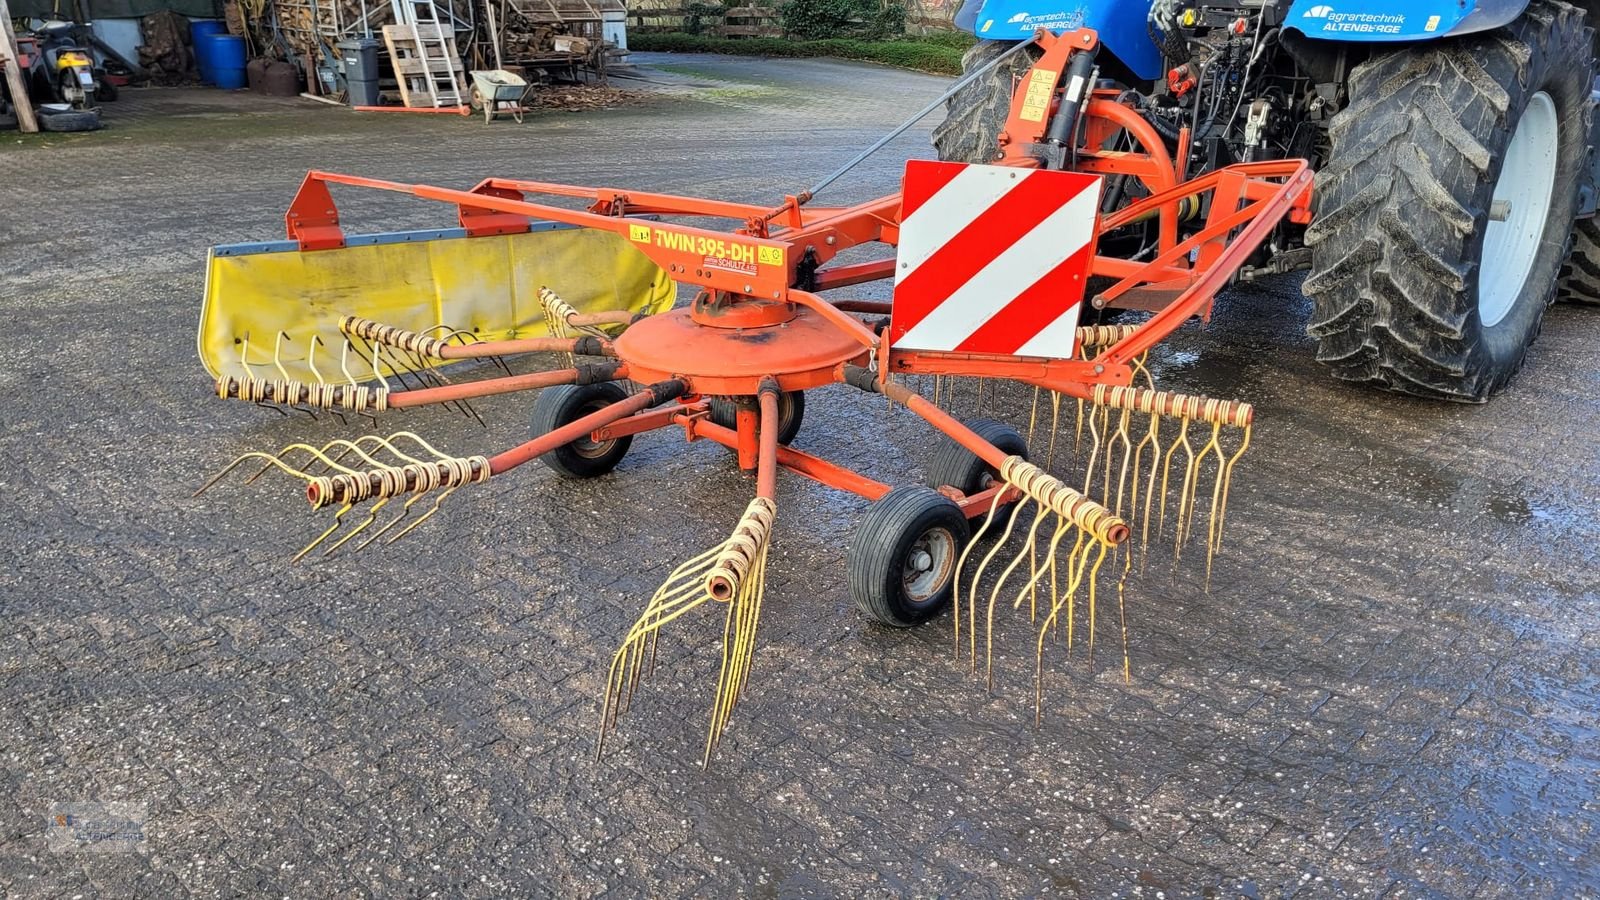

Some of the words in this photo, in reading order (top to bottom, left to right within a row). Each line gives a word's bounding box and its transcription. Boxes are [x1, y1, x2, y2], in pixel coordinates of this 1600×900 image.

[1328, 12, 1405, 23] agrartechnik
[1323, 22, 1402, 34] ALTENBERGE
[655, 229, 694, 253] TWIN
[698, 237, 754, 264] 395-DH
[718, 258, 746, 270] SCHULTZ
